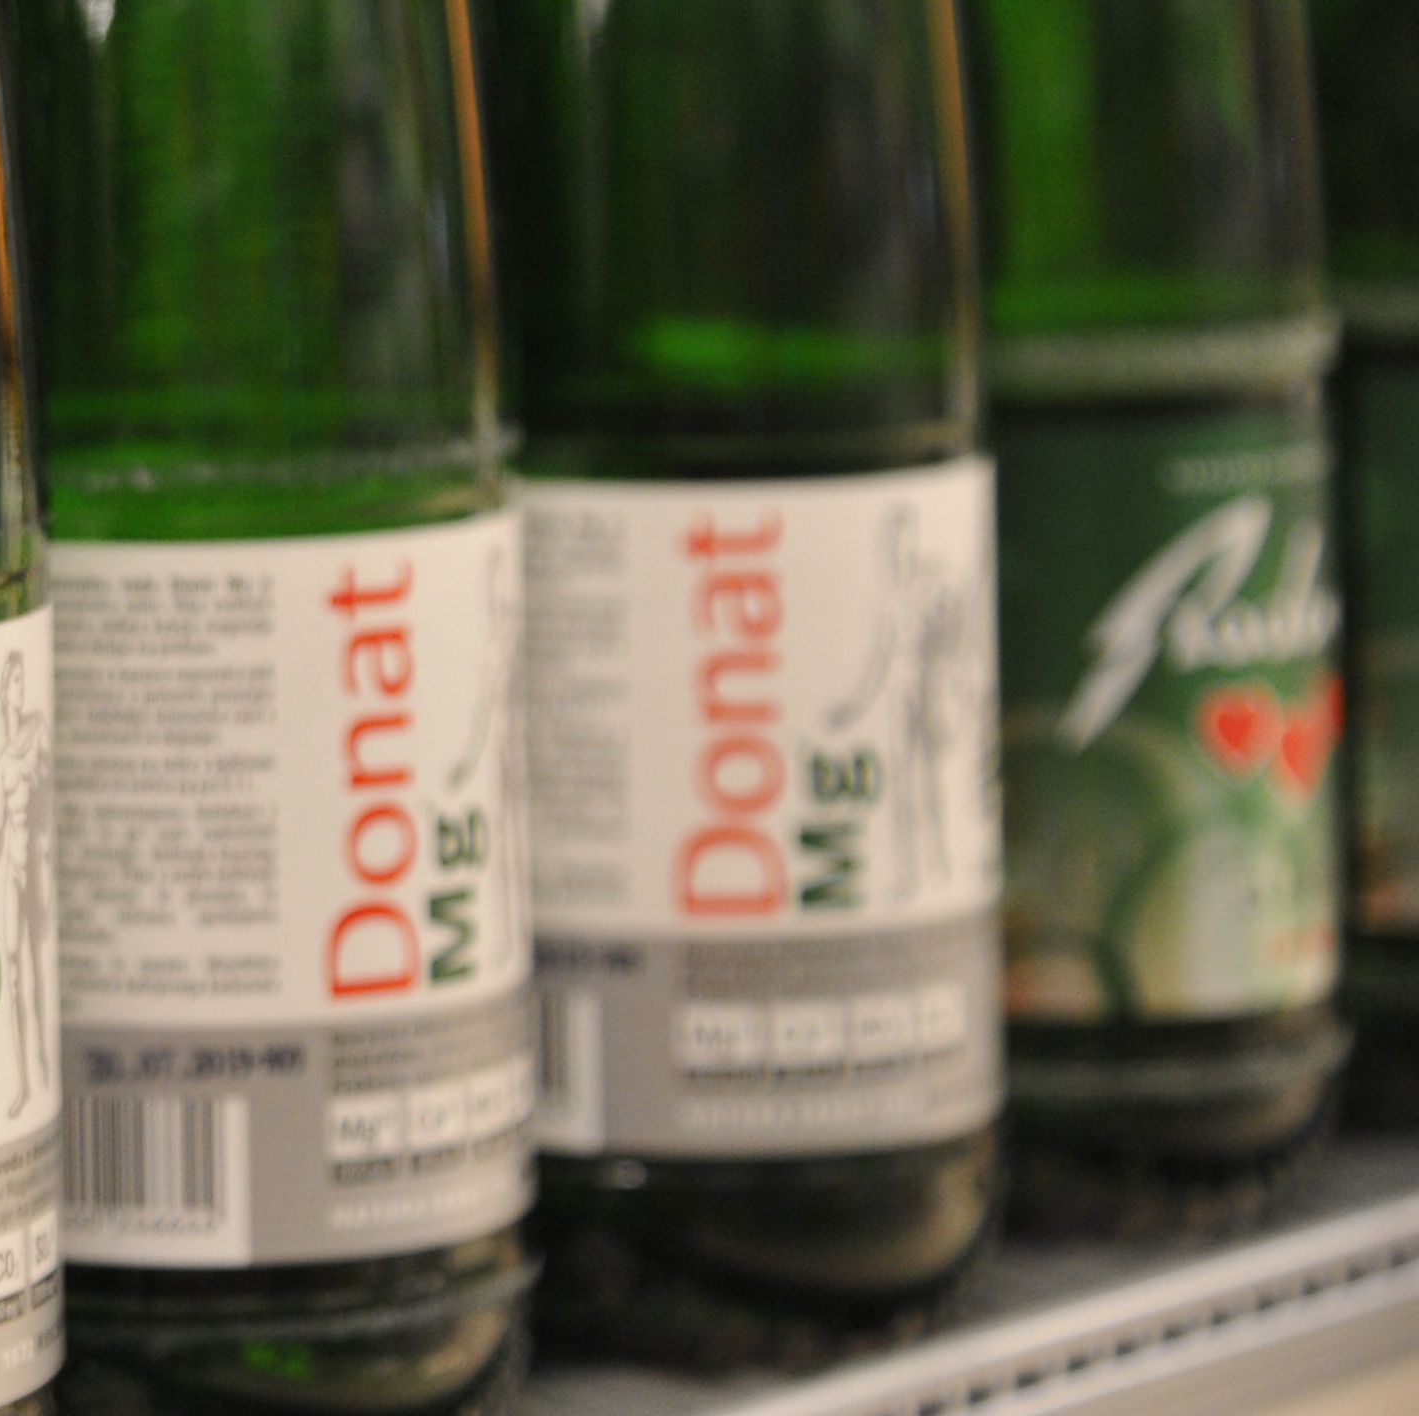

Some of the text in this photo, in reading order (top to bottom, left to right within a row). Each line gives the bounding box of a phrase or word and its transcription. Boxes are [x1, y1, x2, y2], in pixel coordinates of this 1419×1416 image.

[324, 560, 422, 1001] Donat
[428, 806, 490, 985] Mg
[676, 509, 788, 918] Donat
